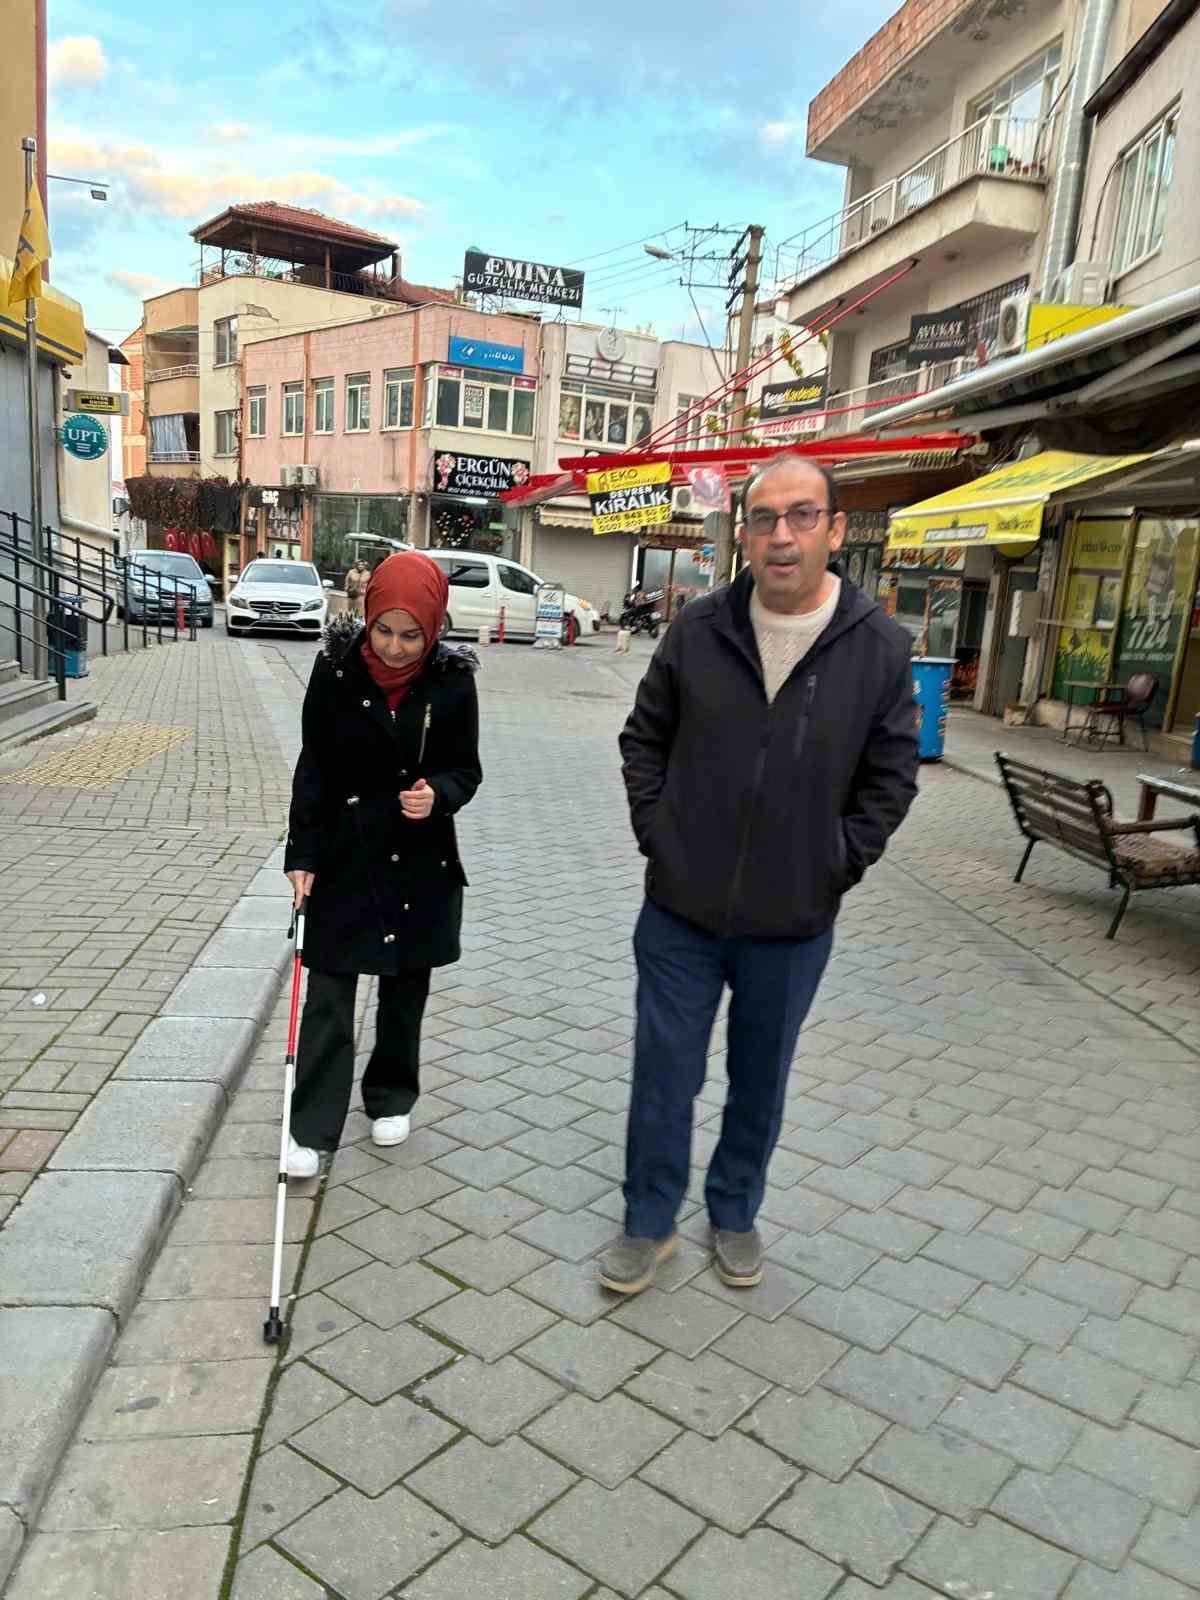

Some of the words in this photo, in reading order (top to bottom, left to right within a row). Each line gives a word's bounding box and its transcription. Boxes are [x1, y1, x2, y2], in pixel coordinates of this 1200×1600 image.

[67, 428, 101, 443] UPT
[456, 457, 512, 477] ERGÜN
[609, 468, 638, 482] EKO
[455, 472, 510, 490] ÇİÇEKÇİLİK
[262, 490, 279, 507] SAÇ
[609, 485, 653, 500] DEVREN
[1125, 618, 1171, 650] 7/24
